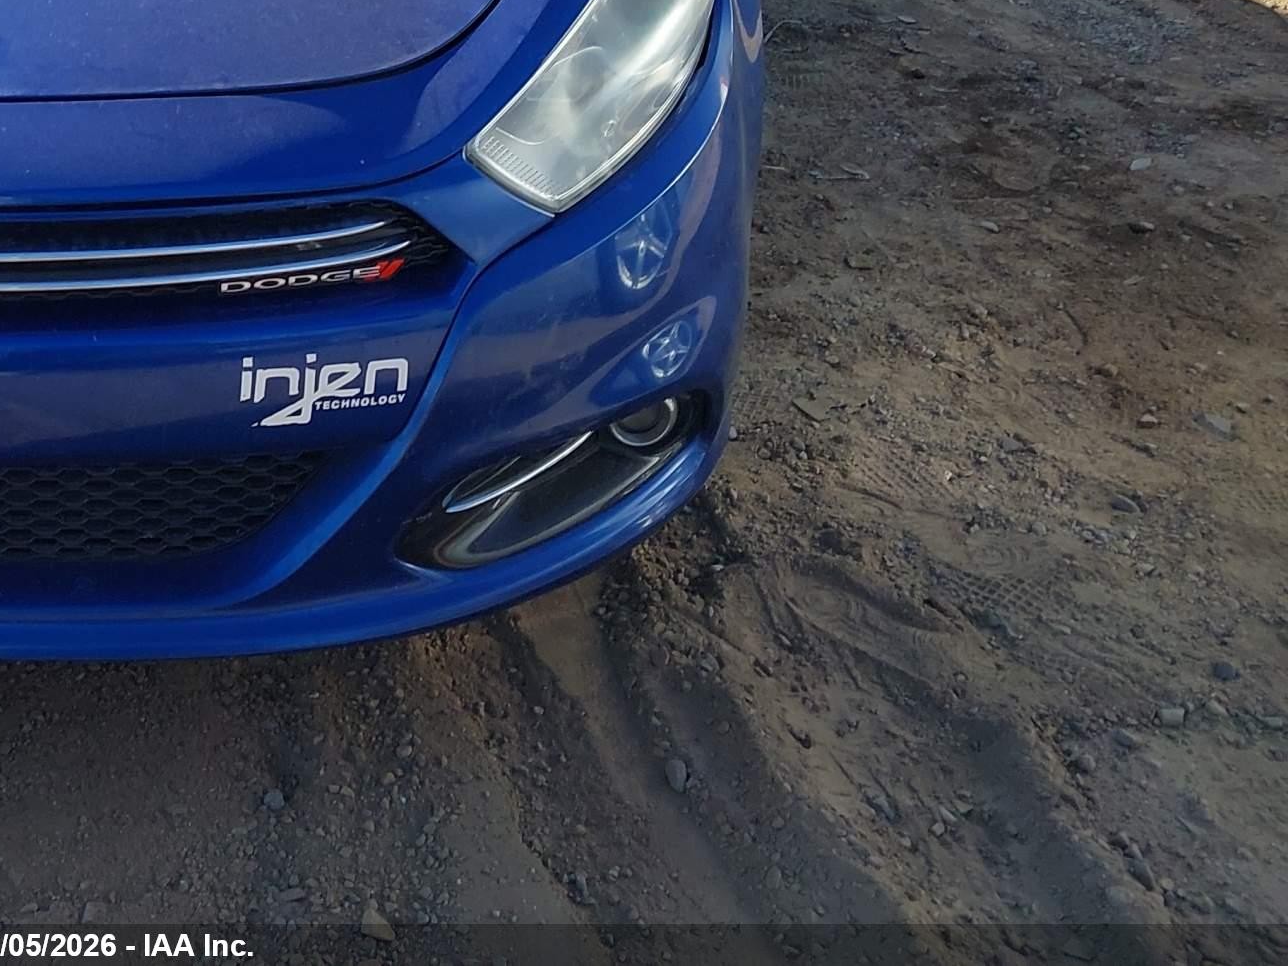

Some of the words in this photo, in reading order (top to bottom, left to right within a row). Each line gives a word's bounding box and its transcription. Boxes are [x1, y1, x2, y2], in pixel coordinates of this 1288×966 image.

[220, 265, 381, 294] DODGE
[239, 353, 409, 427] injen
[314, 393, 406, 411] TECHNOLOGY
